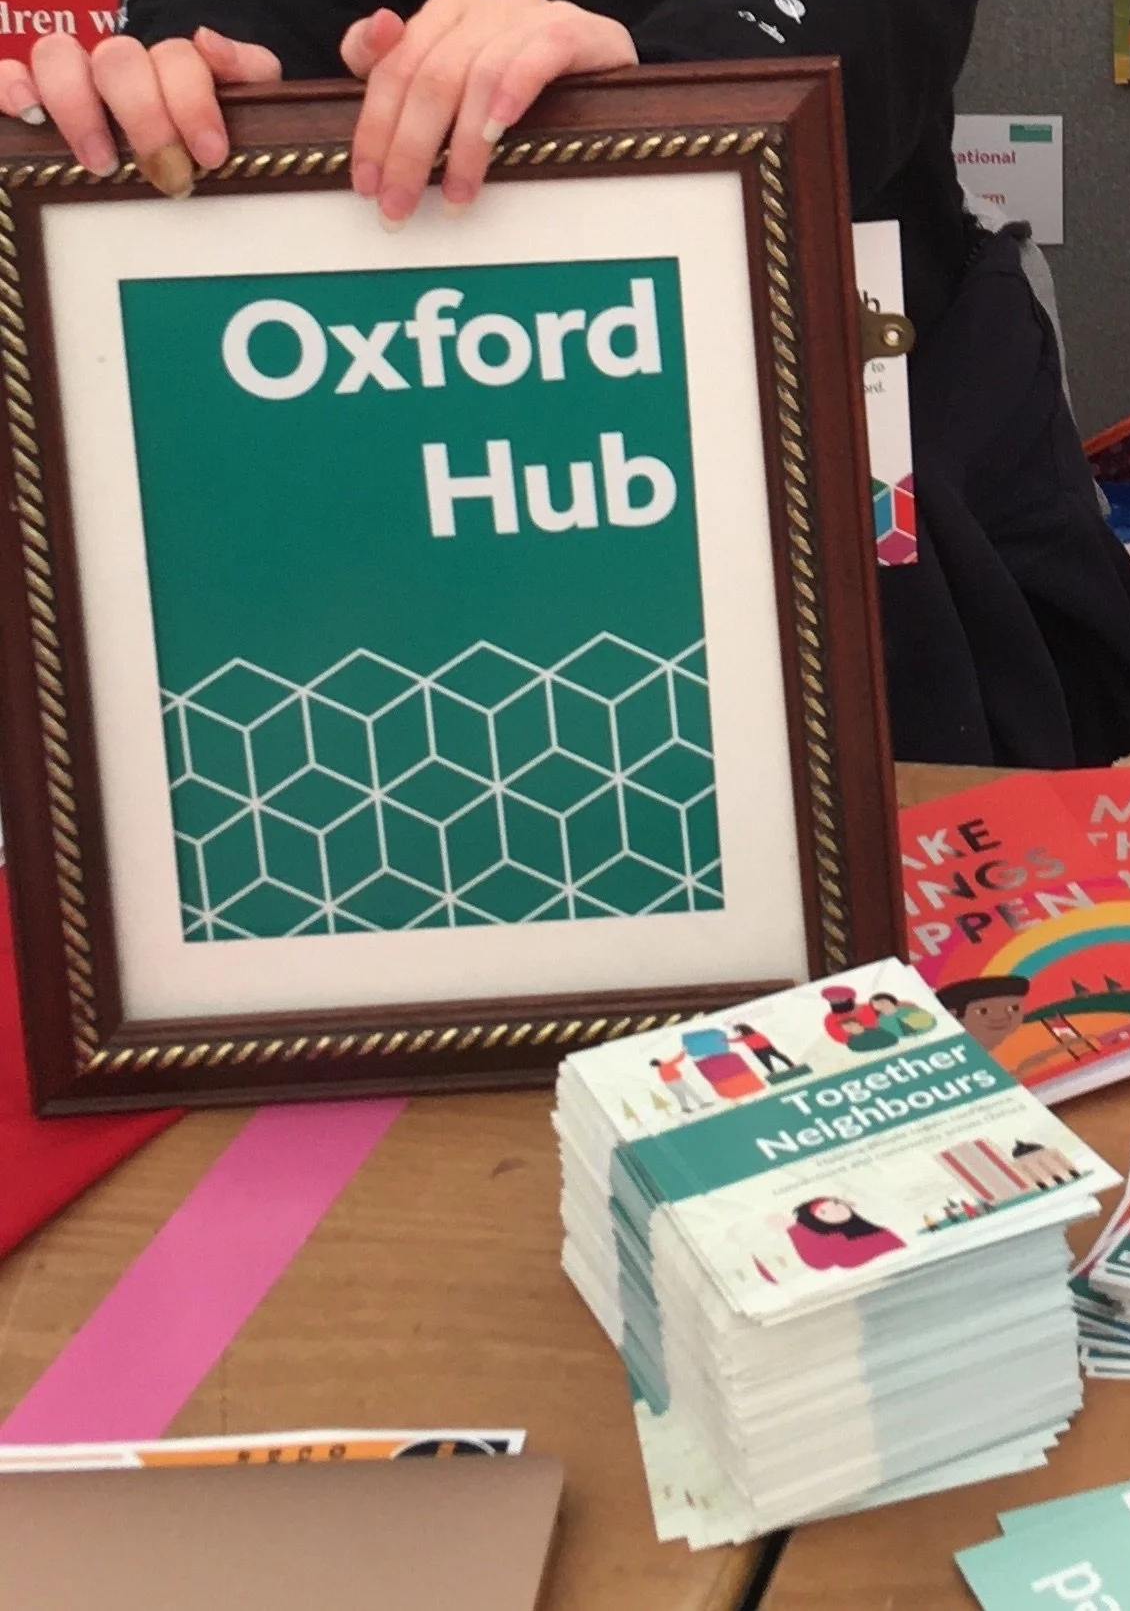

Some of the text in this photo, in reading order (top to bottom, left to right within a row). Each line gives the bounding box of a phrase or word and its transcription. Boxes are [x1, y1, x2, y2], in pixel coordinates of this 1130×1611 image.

[952, 149, 1016, 164] ational
[221, 277, 663, 401] Oxford
[422, 431, 678, 539] Hub
[755, 1069, 997, 1161] Neighbours
[780, 1044, 969, 1117] Together
